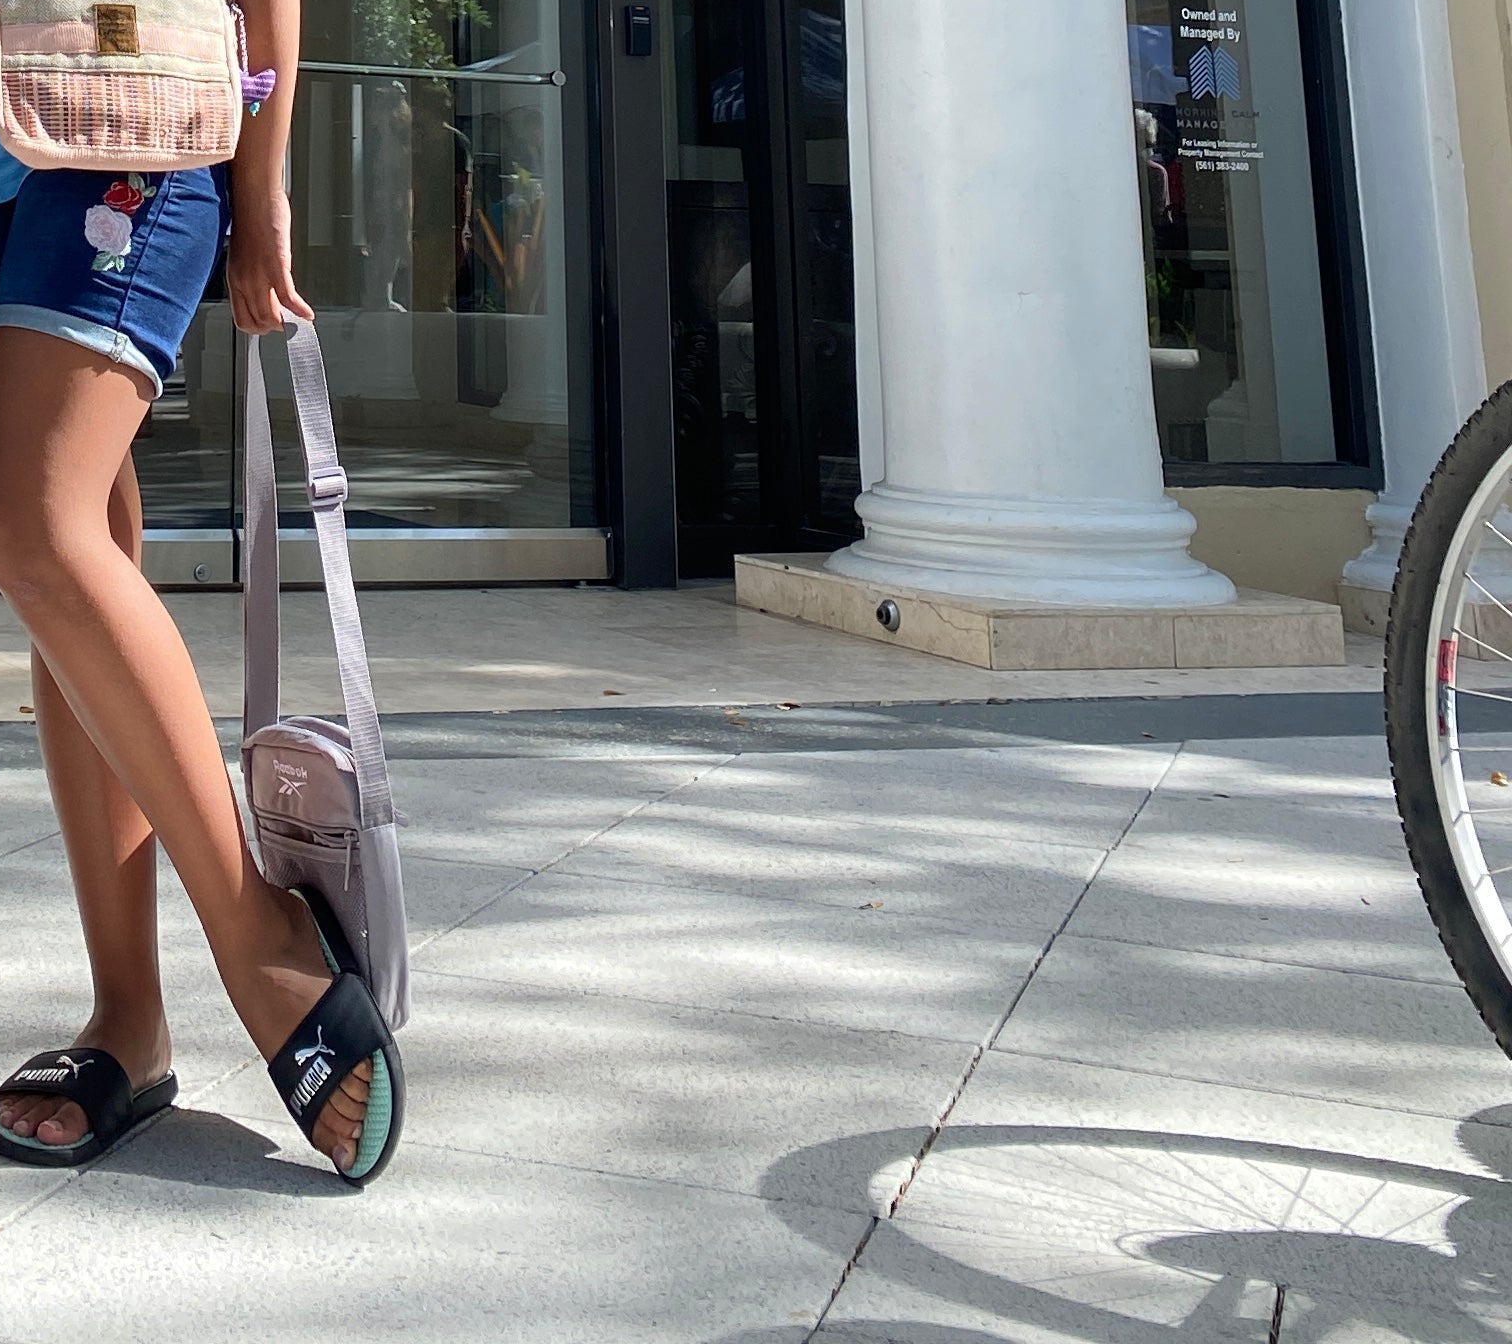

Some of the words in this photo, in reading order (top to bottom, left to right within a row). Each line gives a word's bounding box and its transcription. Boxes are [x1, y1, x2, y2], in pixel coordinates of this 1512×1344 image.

[1181, 7, 1216, 21] Owned
[1218, 10, 1237, 22] and
[1179, 25, 1225, 42] Managed
[1226, 27, 1241, 43] By
[1195, 160, 1215, 172] (561)
[13, 1068, 70, 1083] PUMA
[289, 1055, 333, 1117] PUMA
